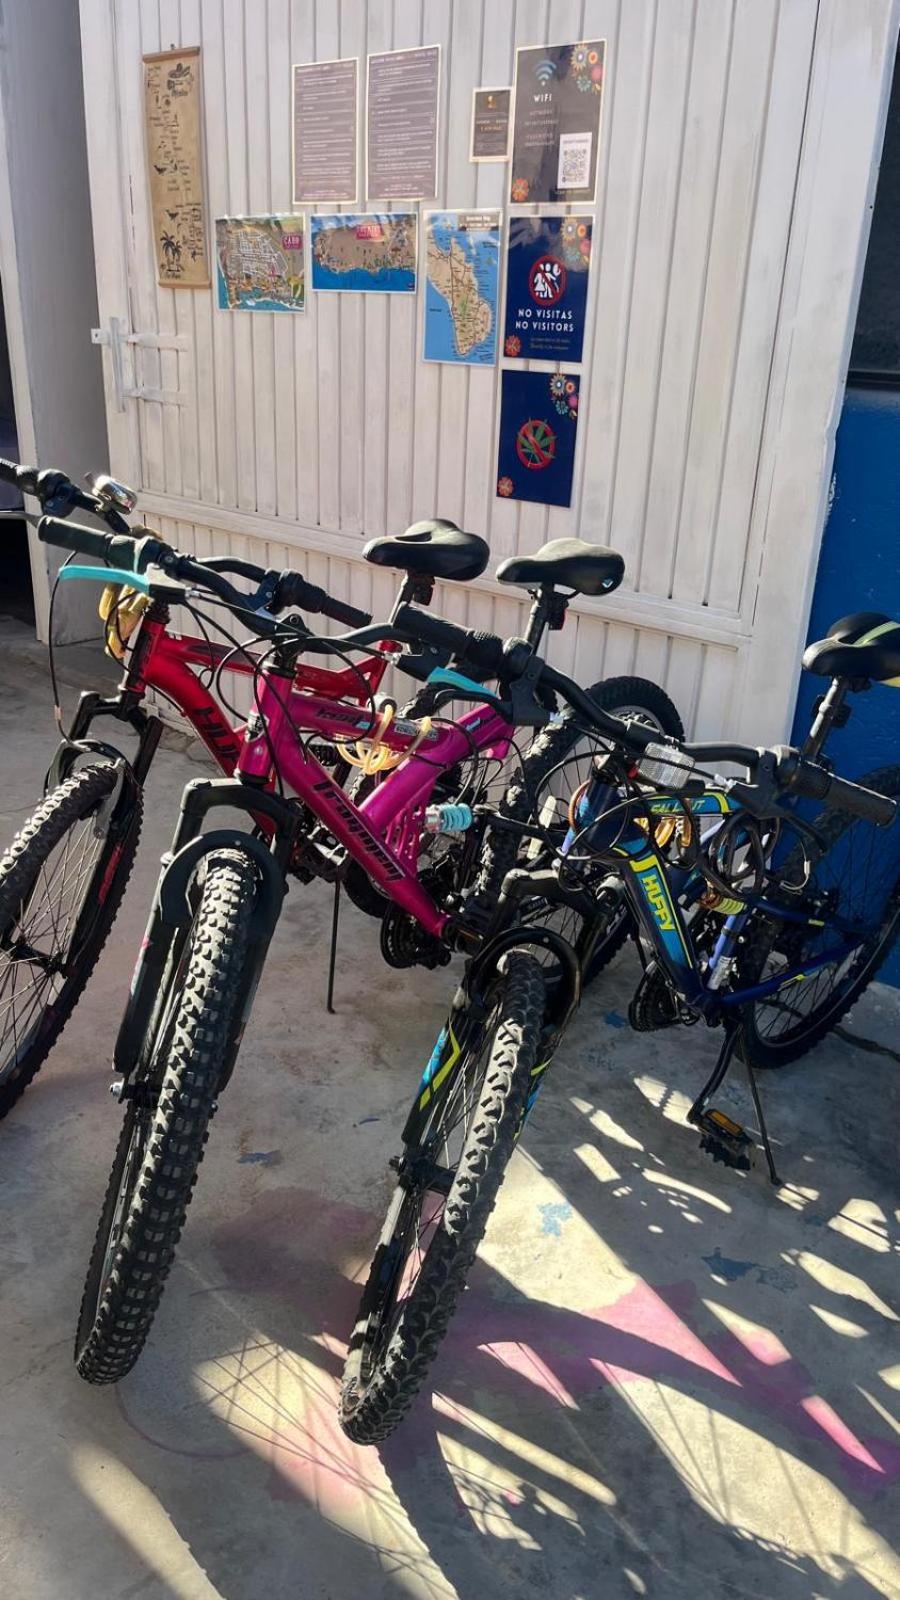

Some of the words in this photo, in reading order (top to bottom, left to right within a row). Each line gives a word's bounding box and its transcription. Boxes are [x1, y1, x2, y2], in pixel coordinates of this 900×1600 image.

[533, 93, 552, 103] WIFI
[518, 308, 532, 318] NO
[536, 309, 573, 320] VISITAS
[515, 320, 529, 330] NO
[532, 321, 574, 333] VISITORS
[650, 799, 706, 814] FALLUT
[641, 873, 676, 931] HUFFY
